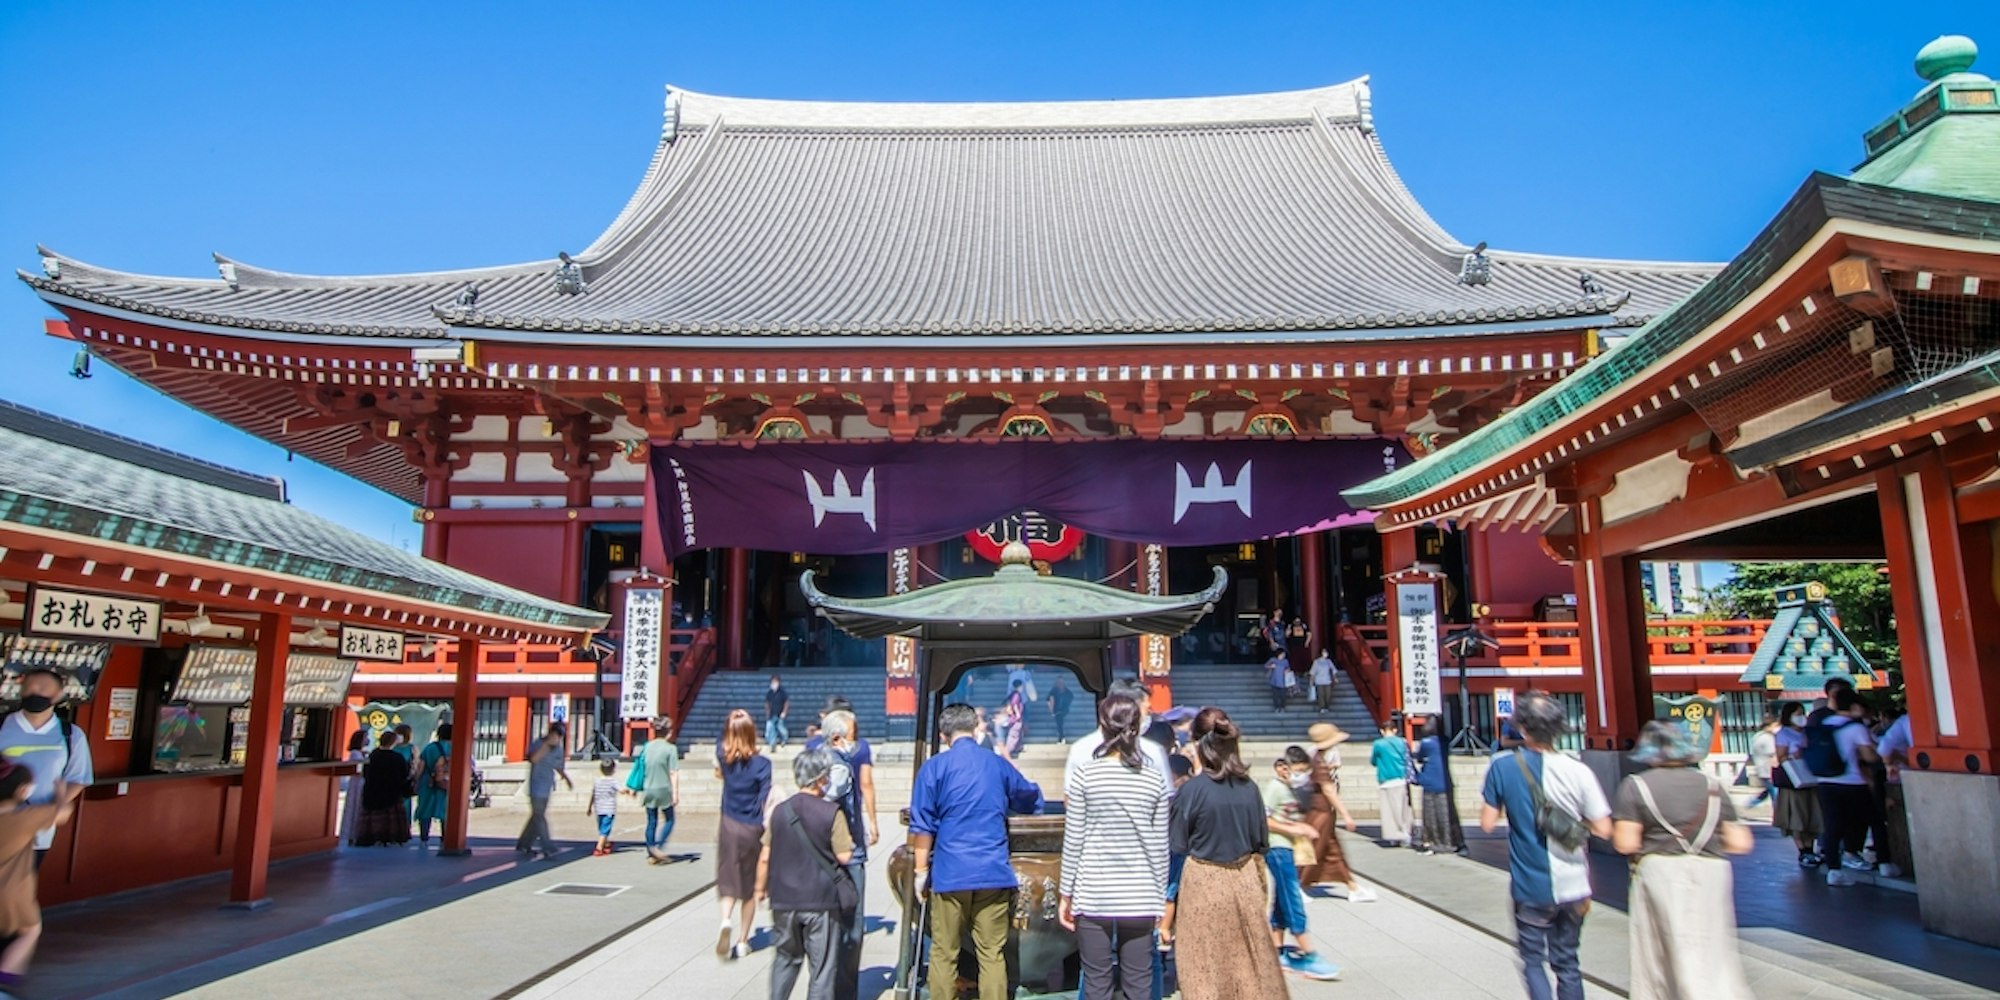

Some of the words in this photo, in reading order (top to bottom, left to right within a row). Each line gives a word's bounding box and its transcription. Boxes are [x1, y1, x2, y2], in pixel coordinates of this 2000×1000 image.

[41, 596, 148, 635] お札お守
[345, 631, 398, 657] お札お守
